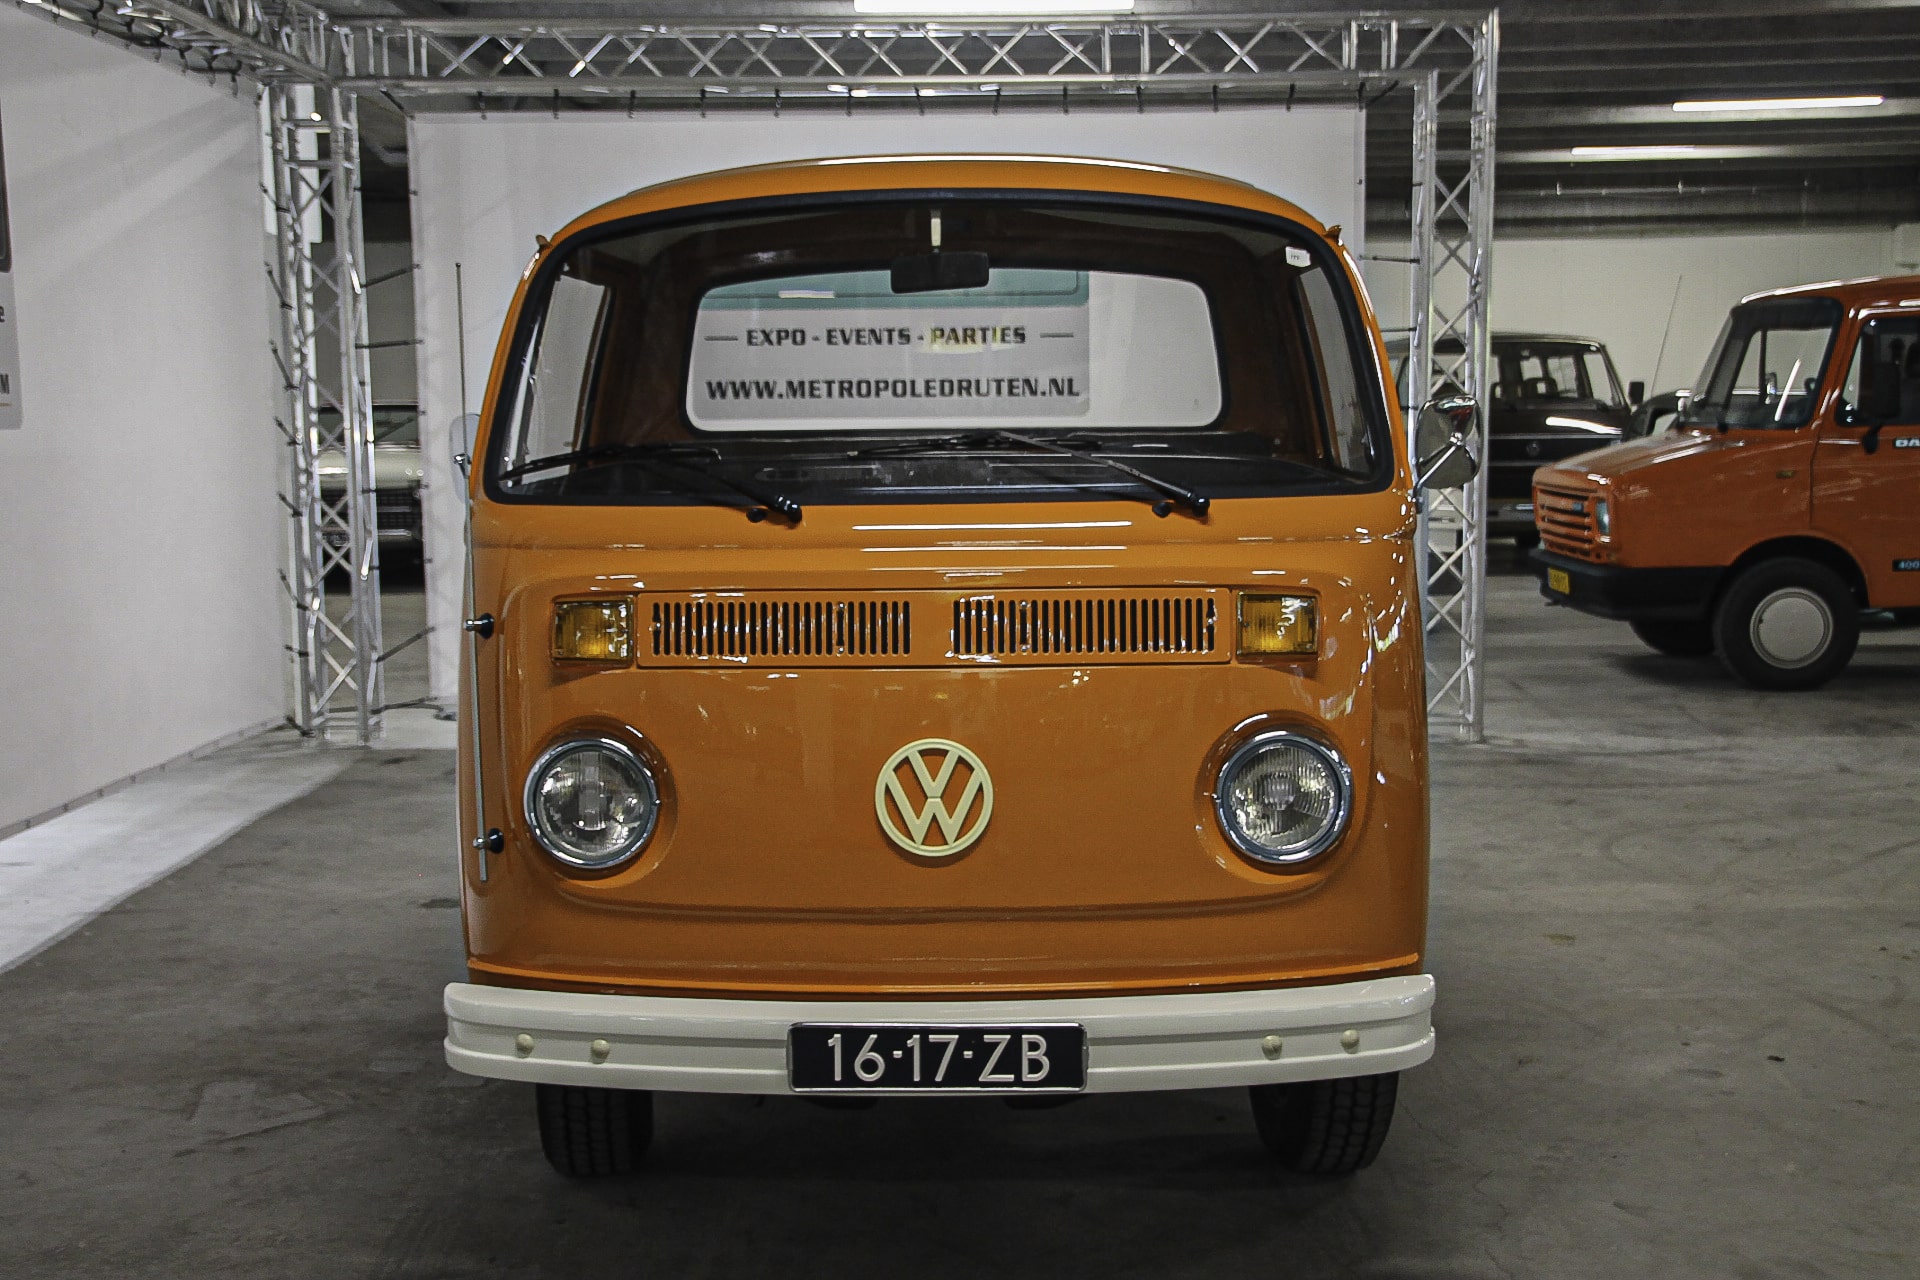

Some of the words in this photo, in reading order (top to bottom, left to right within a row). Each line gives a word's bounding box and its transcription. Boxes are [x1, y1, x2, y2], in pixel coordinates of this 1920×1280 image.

[746, 328, 806, 346] EXPO
[825, 327, 911, 346] EVENTS
[930, 327, 1027, 345] PARTIES
[705, 377, 1080, 400] WWW.METROPOLEDRUTEN.NL
[876, 739, 993, 856] VW
[828, 1034, 1050, 1081] 16-17-ZB
